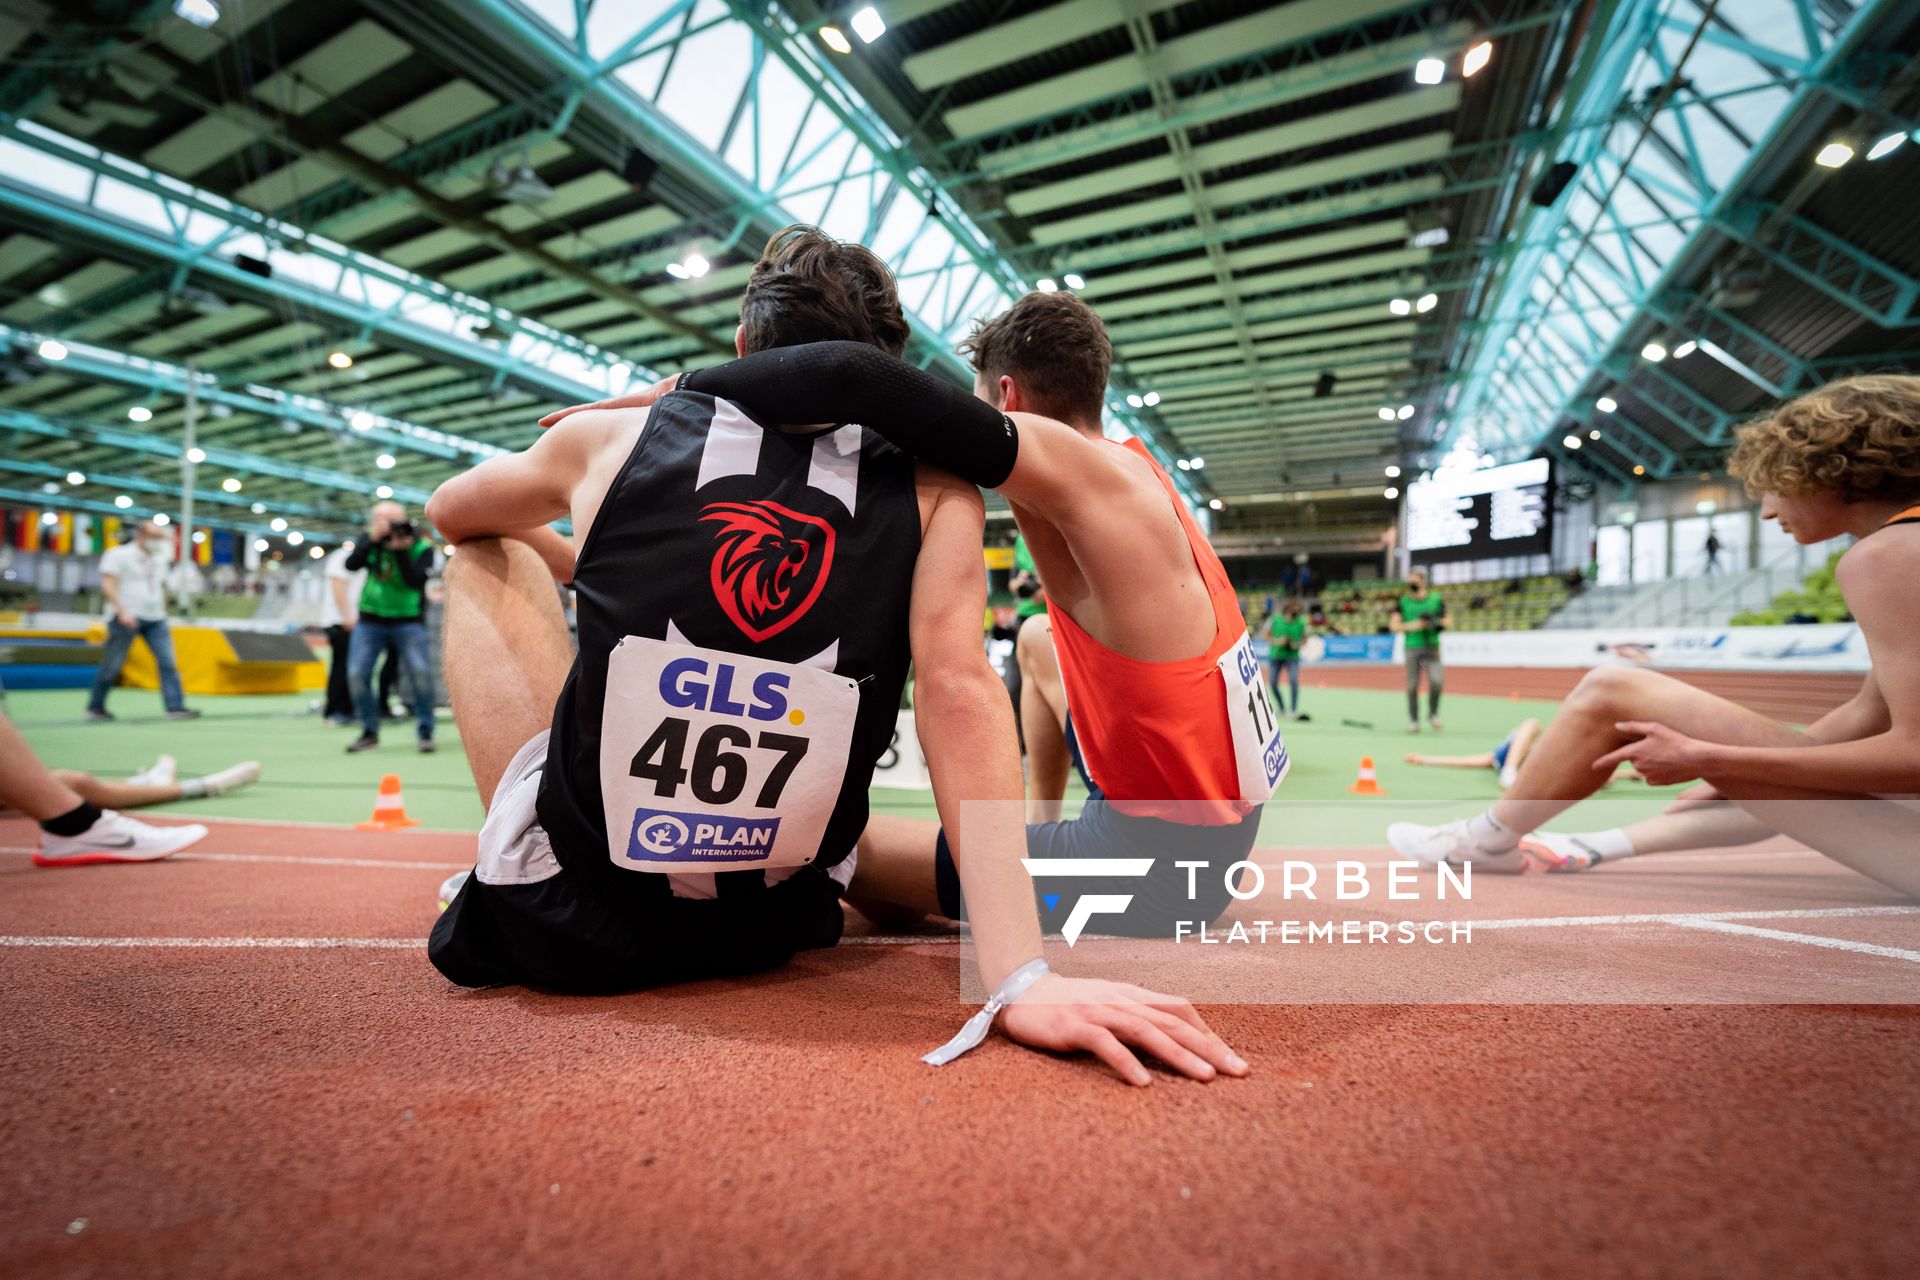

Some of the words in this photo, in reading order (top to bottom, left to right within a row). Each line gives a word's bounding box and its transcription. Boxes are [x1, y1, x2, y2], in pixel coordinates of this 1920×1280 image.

[1248, 680, 1274, 746] 11
[628, 716, 810, 809] 467
[691, 848, 765, 857] INTERNATIONAL
[693, 823, 772, 847] PLAN
